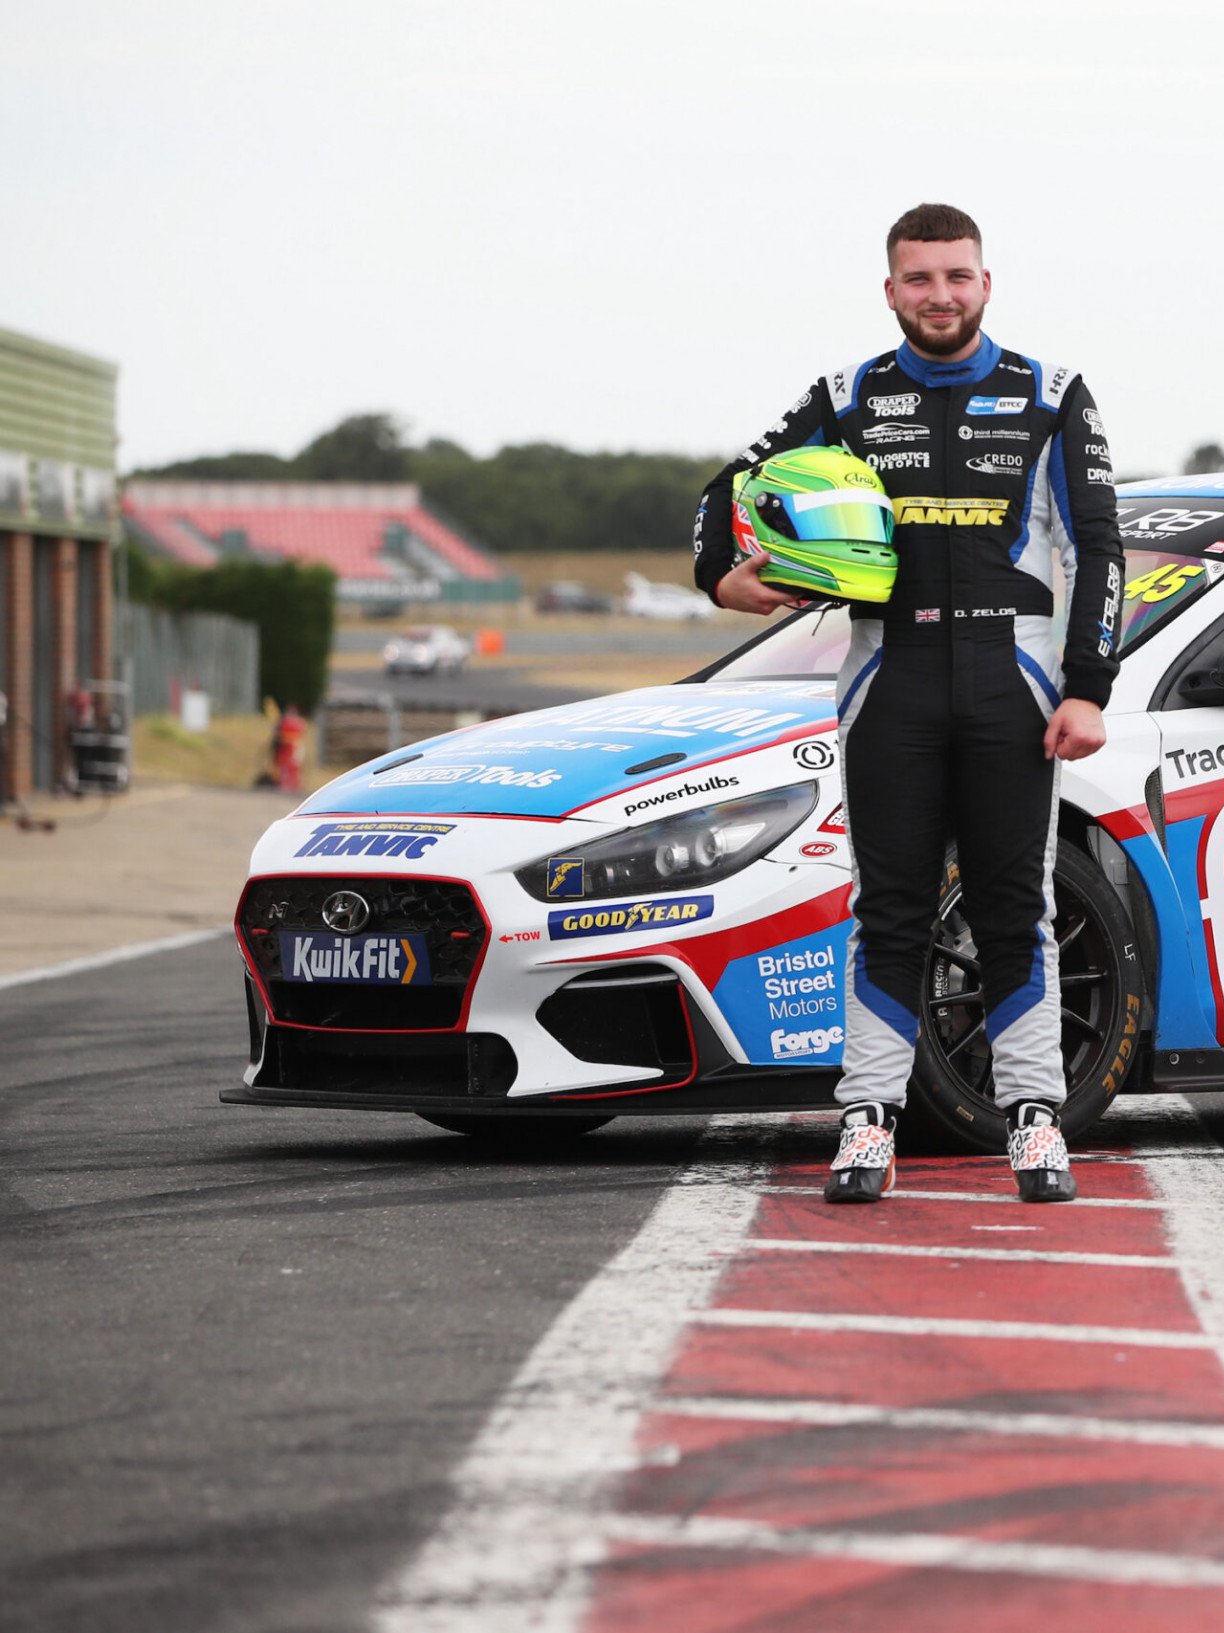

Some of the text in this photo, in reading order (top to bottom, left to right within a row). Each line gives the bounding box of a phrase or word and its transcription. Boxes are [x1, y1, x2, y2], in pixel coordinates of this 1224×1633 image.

[873, 395, 916, 407] DRAPER
[874, 405, 916, 417] Tools
[862, 428, 931, 440] TradePriceCars.com
[876, 436, 916, 444] RACING
[880, 452, 930, 463] LOGISTICS
[880, 457, 931, 471] PEOPLE
[984, 454, 1023, 467] CREDO
[1124, 563, 1206, 603] 45
[954, 607, 1017, 618] D. ZELOS
[466, 765, 563, 788] Tools
[624, 776, 740, 816] powerbulbs
[293, 823, 450, 859] TANVIC
[804, 845, 834, 854] ABS
[514, 931, 541, 943] TOW
[1123, 944, 1137, 961] LF
[757, 945, 835, 977] Bristol
[764, 970, 836, 999] Street
[768, 996, 838, 1020] Motors
[1102, 993, 1140, 1097] EAGLE
